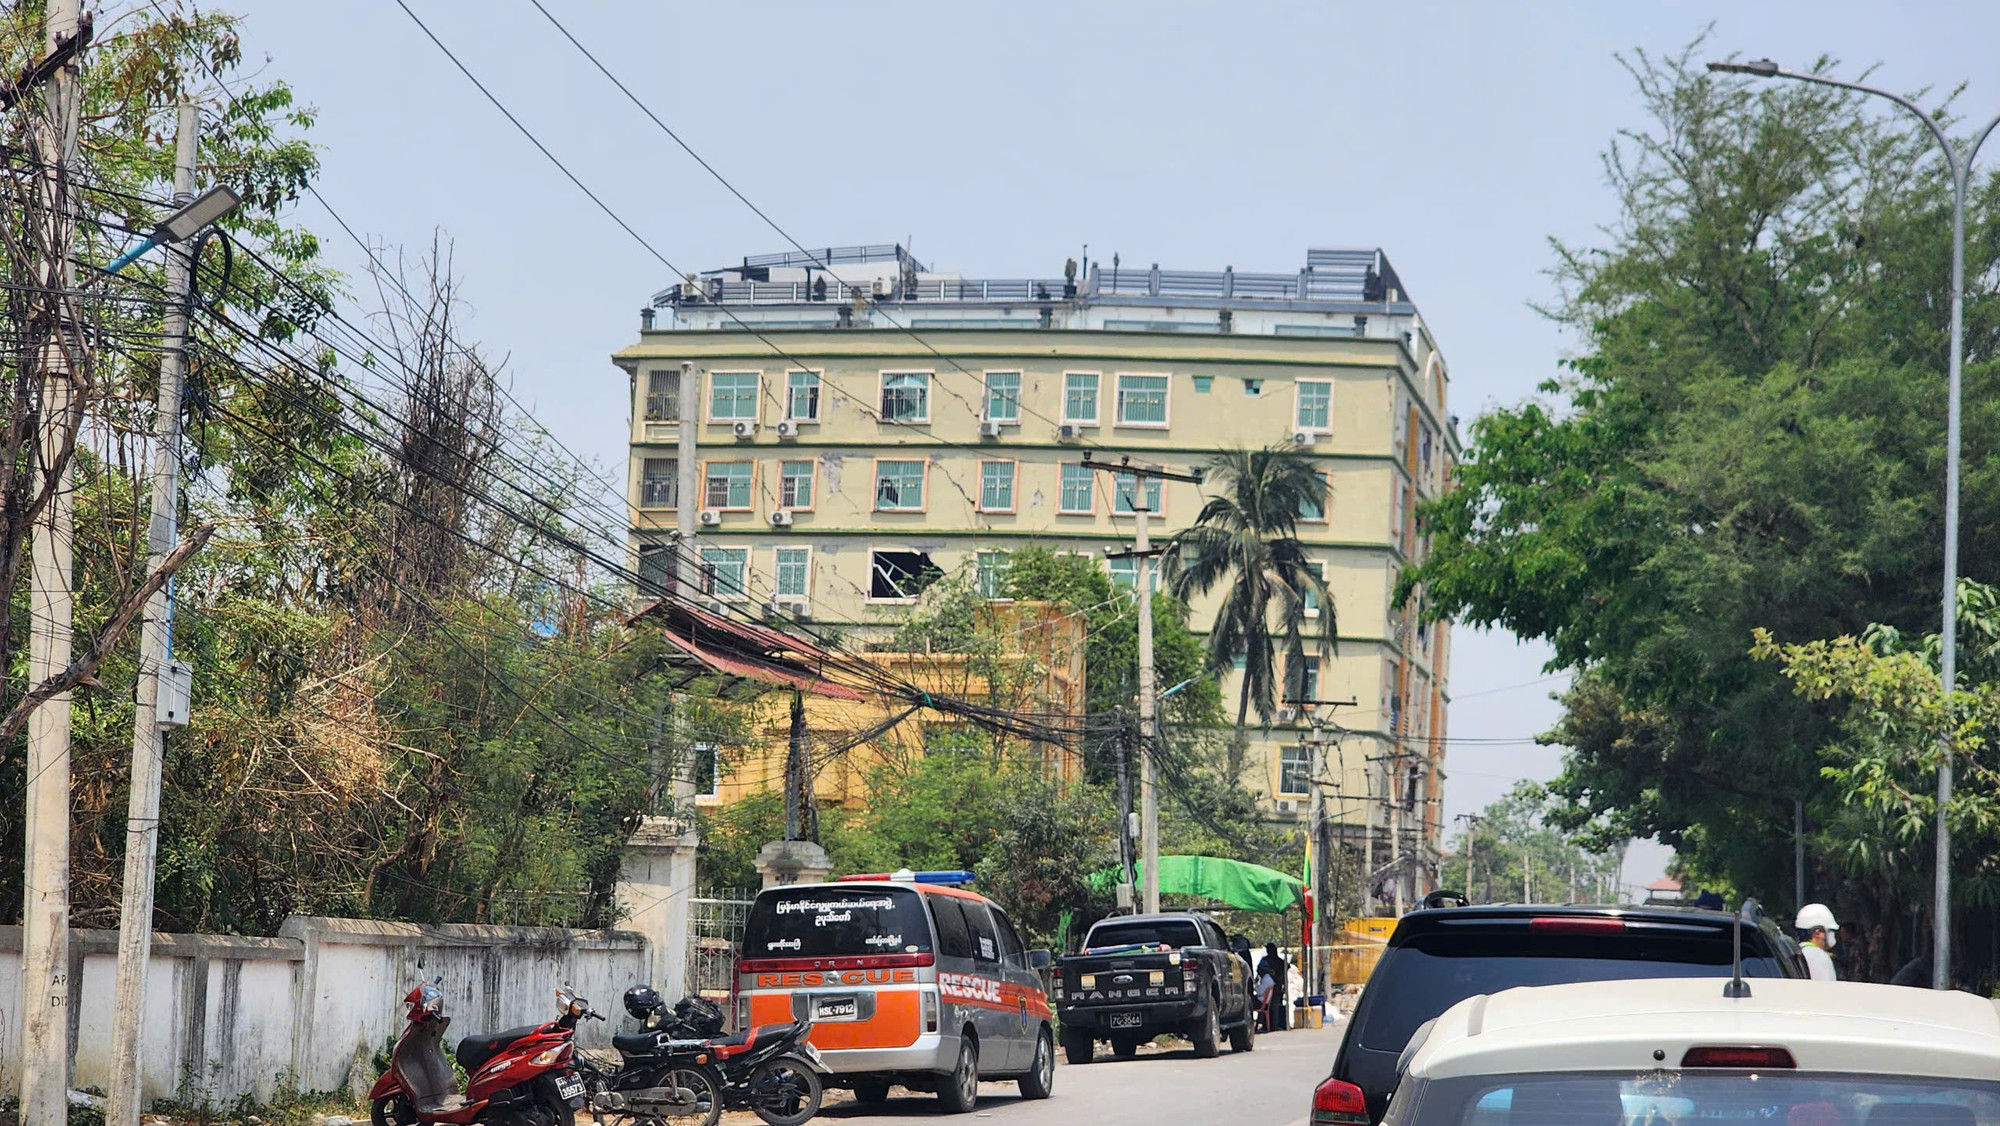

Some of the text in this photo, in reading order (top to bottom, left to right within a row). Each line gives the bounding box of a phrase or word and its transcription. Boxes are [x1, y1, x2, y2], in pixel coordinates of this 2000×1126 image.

[52, 974, 68, 986] AP
[758, 970, 914, 986] RESCUE
[939, 972, 1002, 1003] RESCUE
[1072, 987, 1178, 999] RANGER
